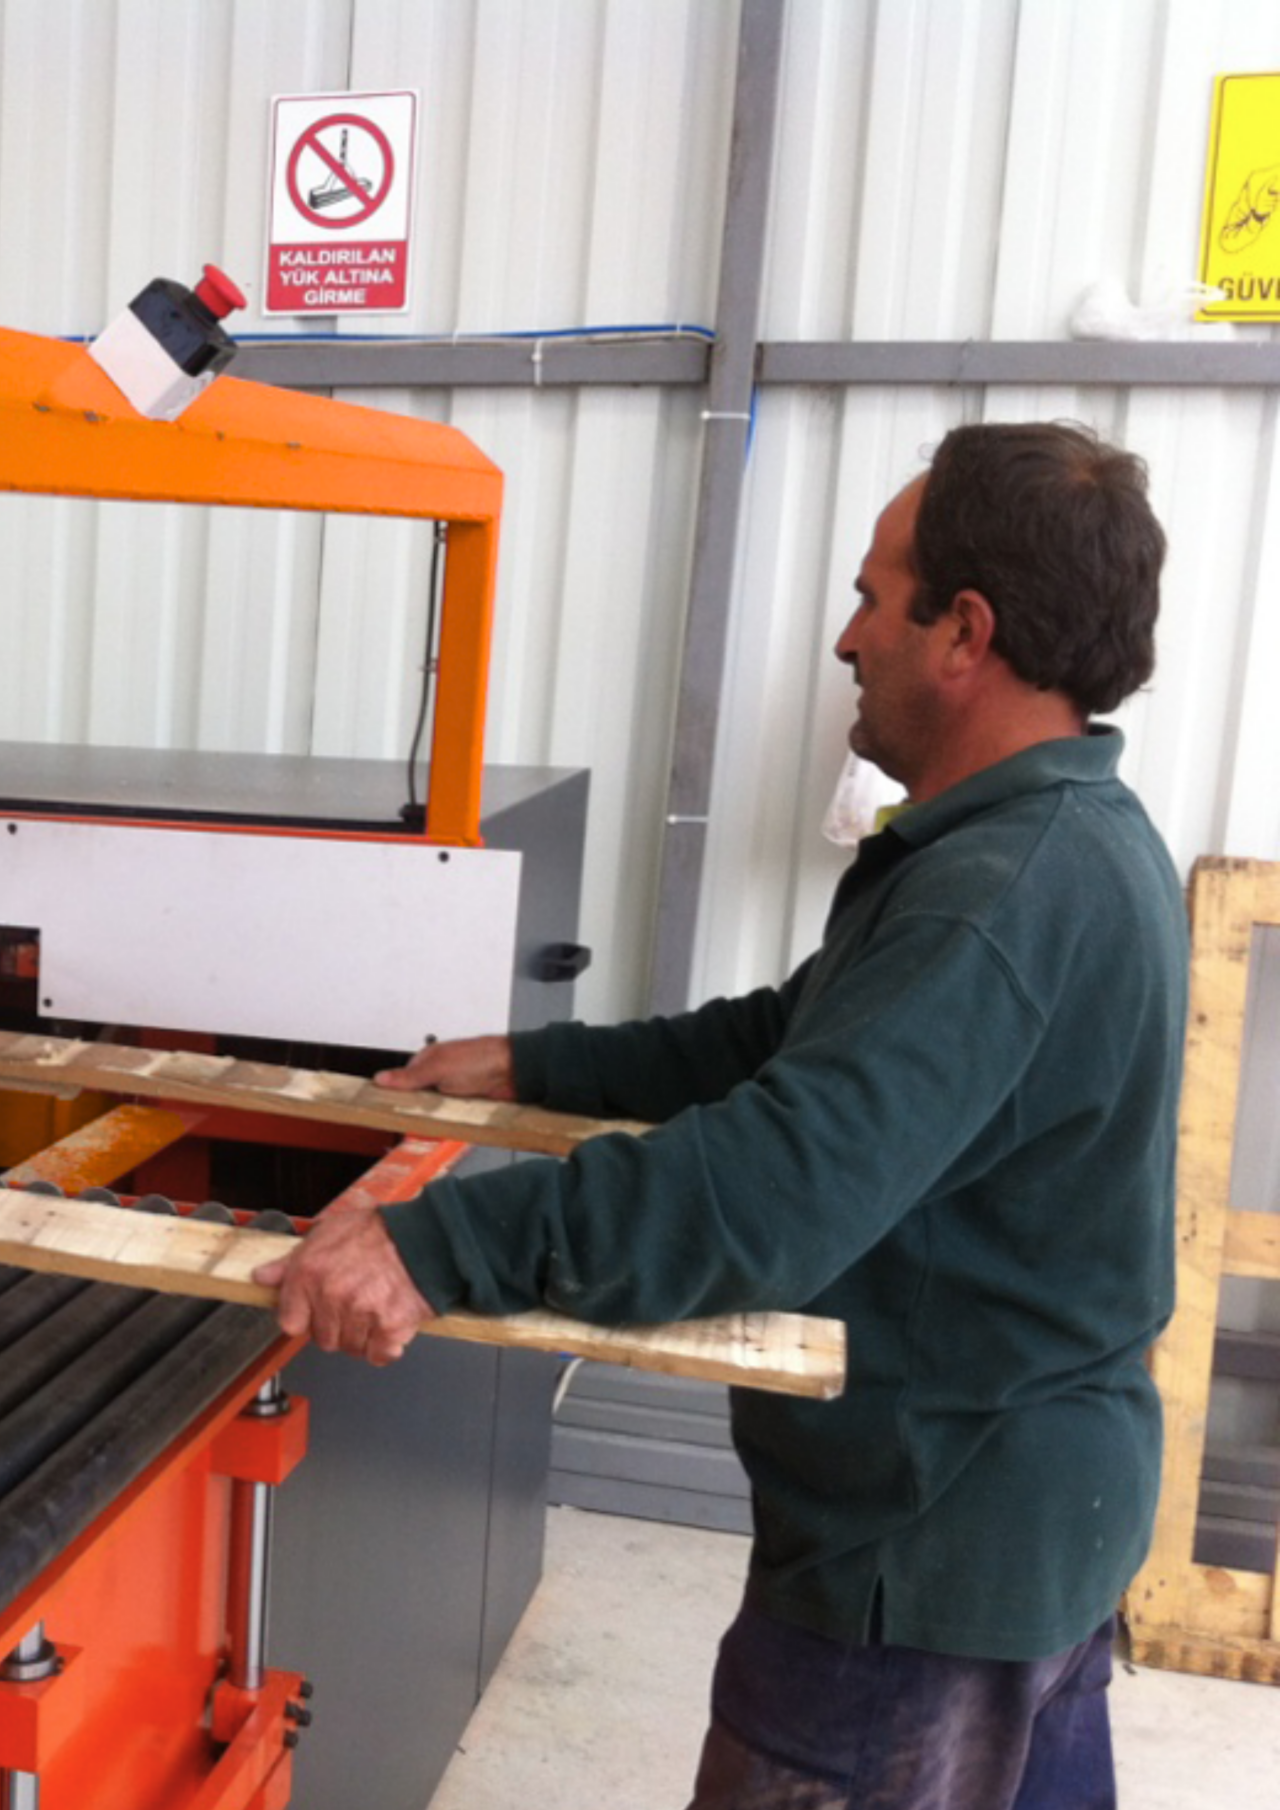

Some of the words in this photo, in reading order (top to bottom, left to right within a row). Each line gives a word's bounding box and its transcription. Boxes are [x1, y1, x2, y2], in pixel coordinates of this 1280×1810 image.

[279, 248, 396, 266] KALDIRILAN
[280, 268, 319, 286] YÜK
[324, 267, 394, 285] ALTINA
[304, 286, 366, 305] GİRME
